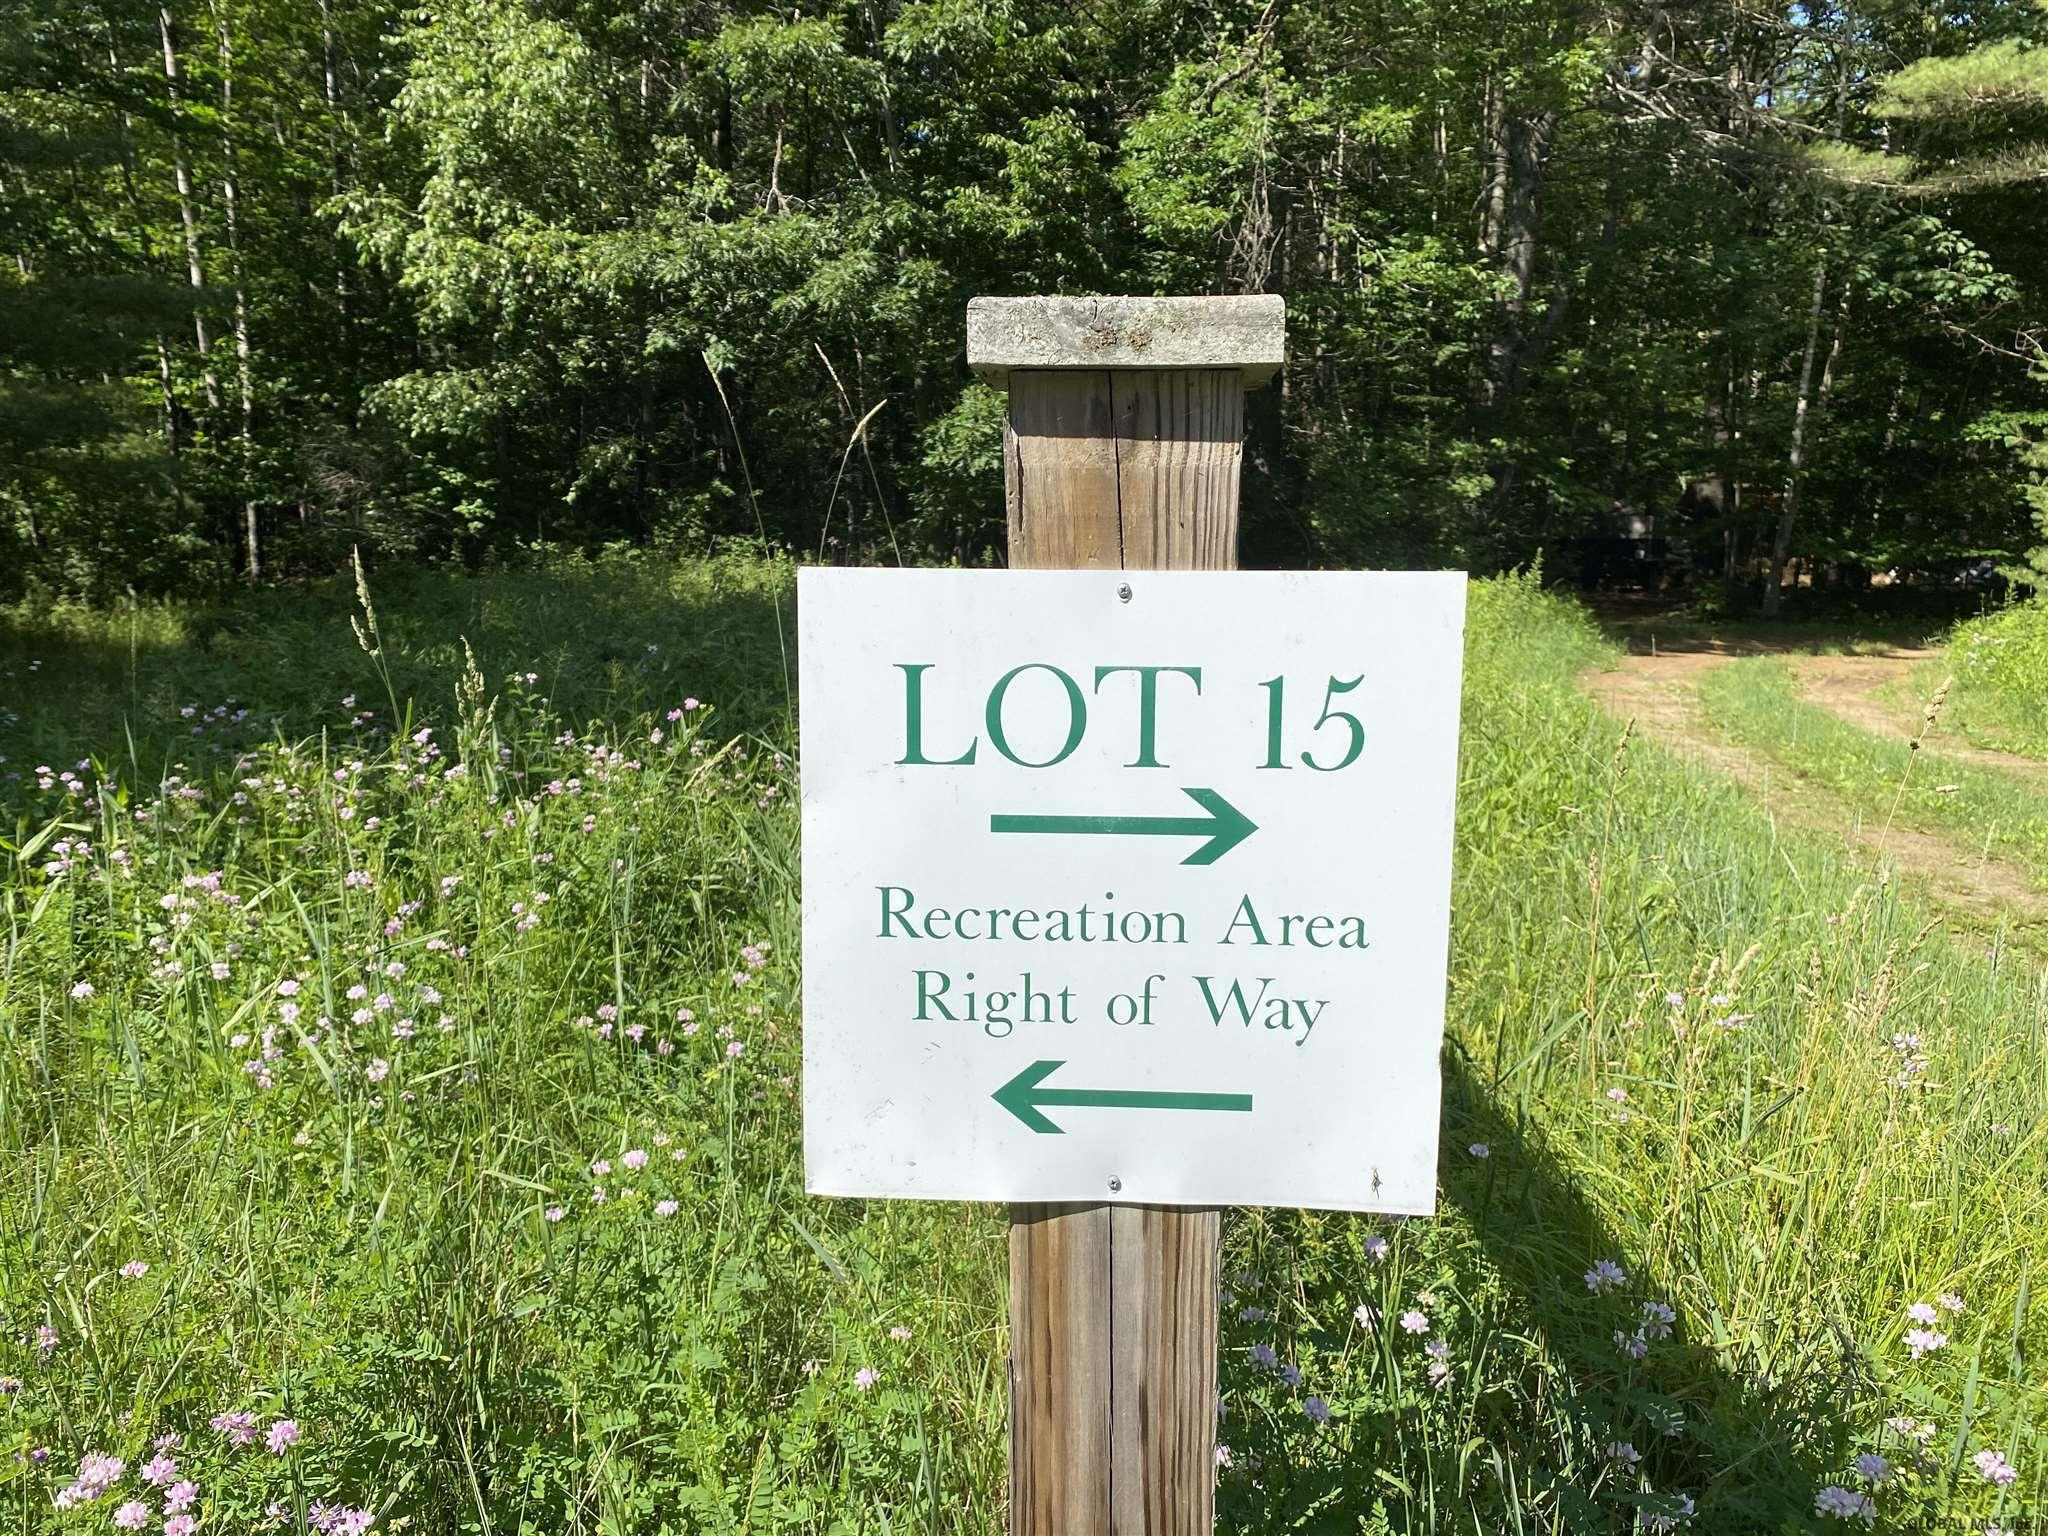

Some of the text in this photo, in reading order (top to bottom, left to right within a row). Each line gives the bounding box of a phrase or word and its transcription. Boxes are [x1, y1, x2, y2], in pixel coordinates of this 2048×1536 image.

[893, 663, 1366, 772] LOT 15
[876, 886, 1370, 949] Recreation Area
[912, 969, 1330, 1047] Right of Way
